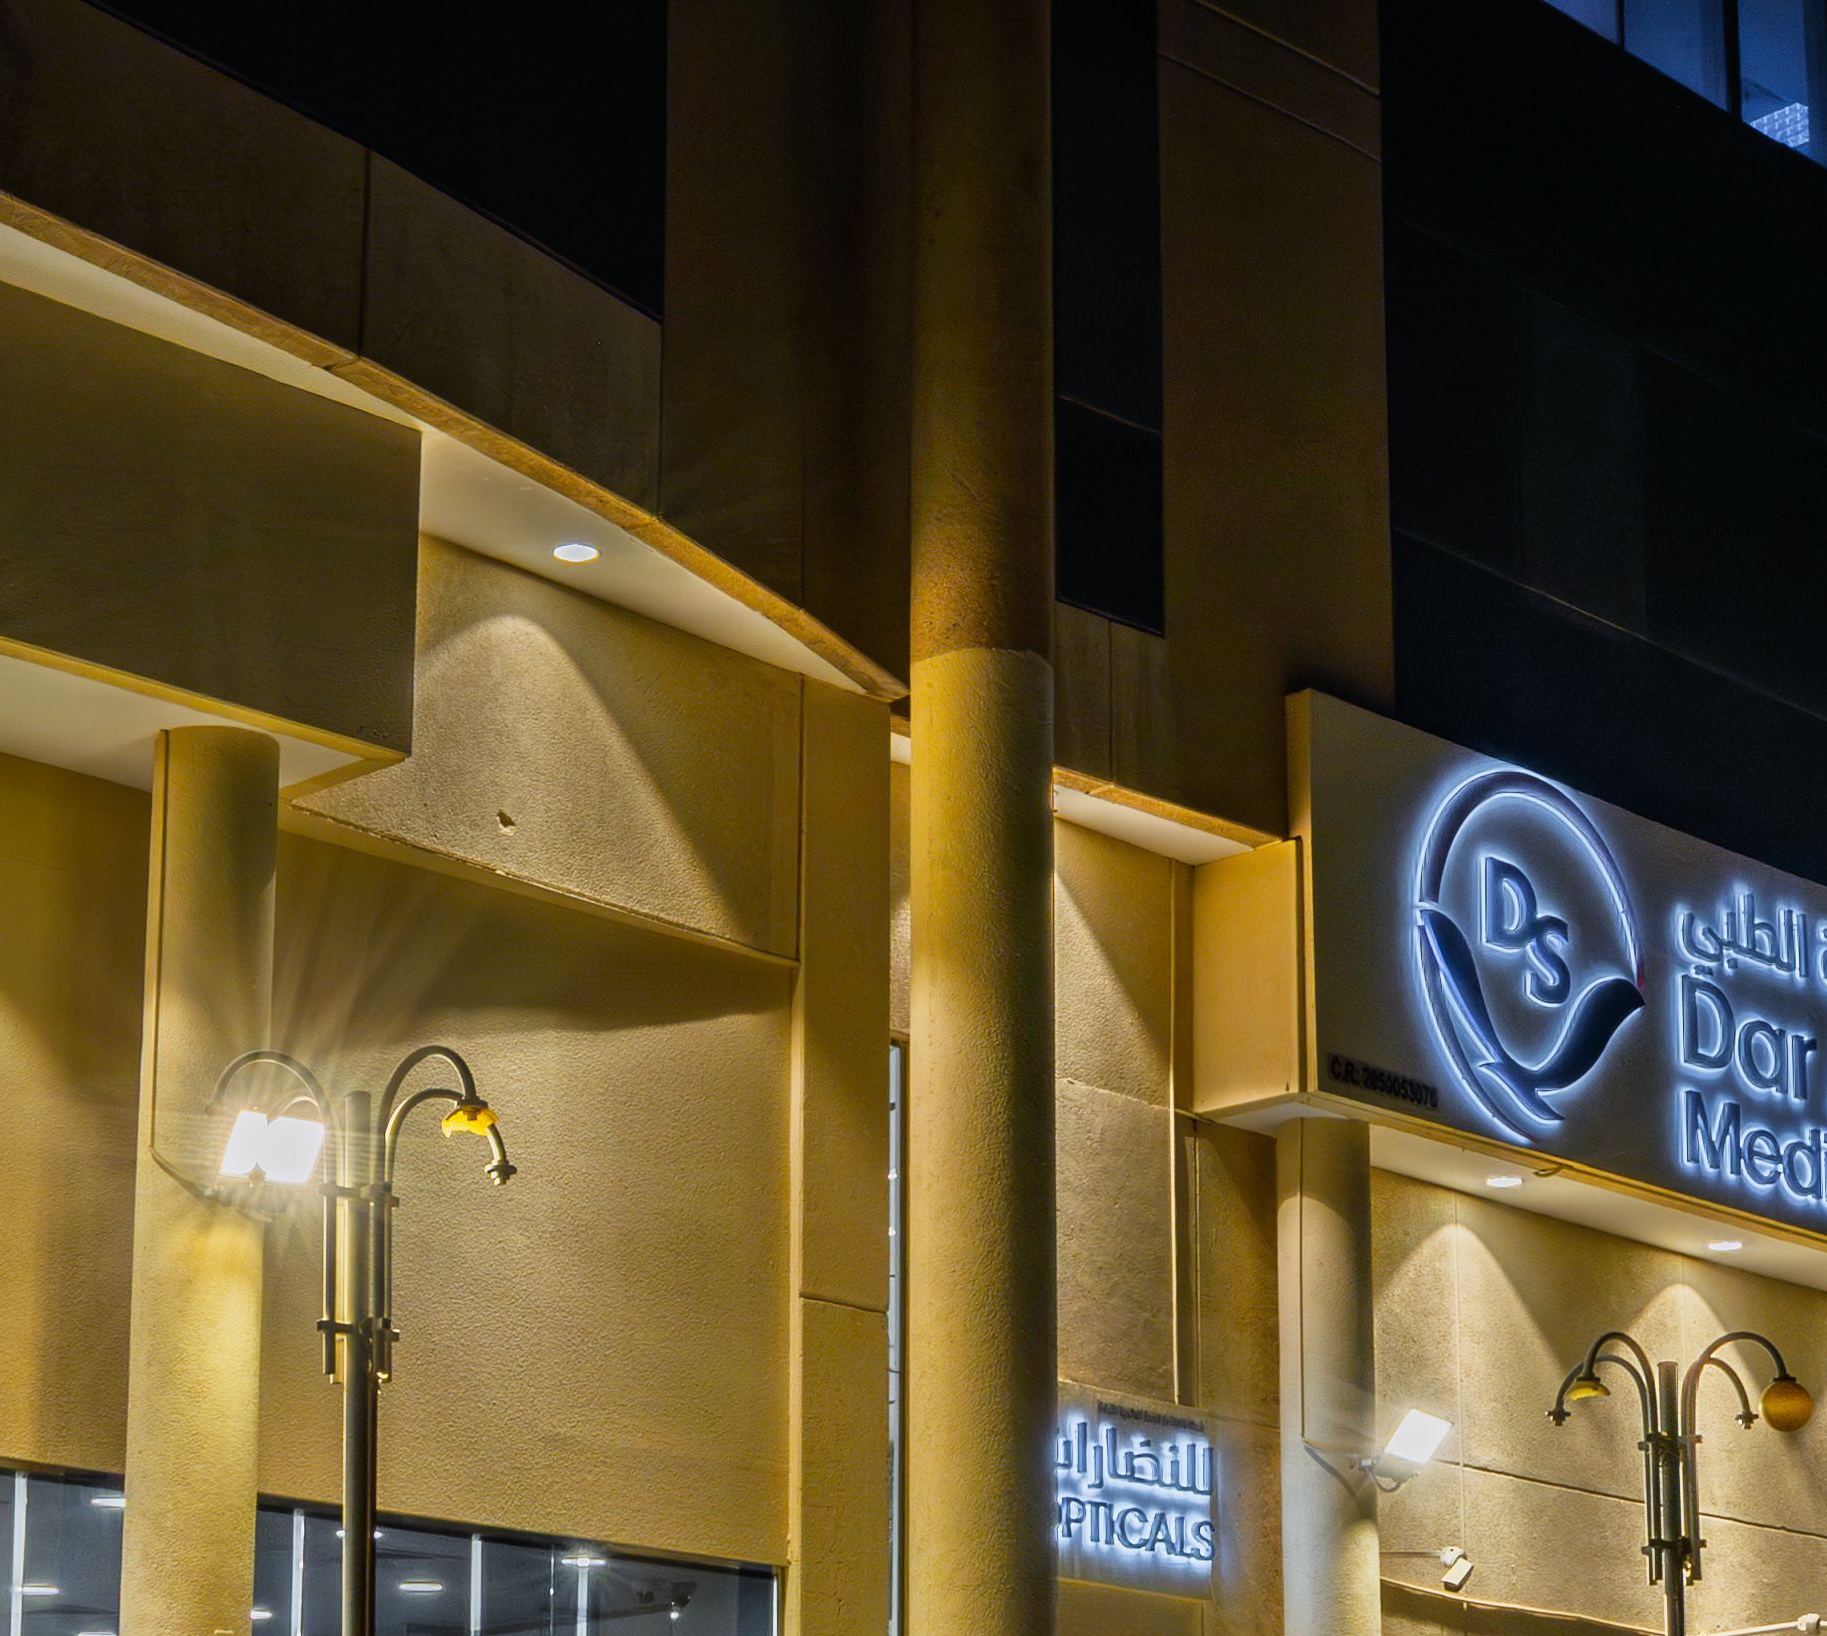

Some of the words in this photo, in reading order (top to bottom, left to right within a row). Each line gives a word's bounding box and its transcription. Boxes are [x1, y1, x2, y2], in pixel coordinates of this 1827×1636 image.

[1682, 893, 1809, 977] الطبي
[1681, 974, 1817, 1099] Dar
[1058, 1496, 1216, 1561] PTICALS
